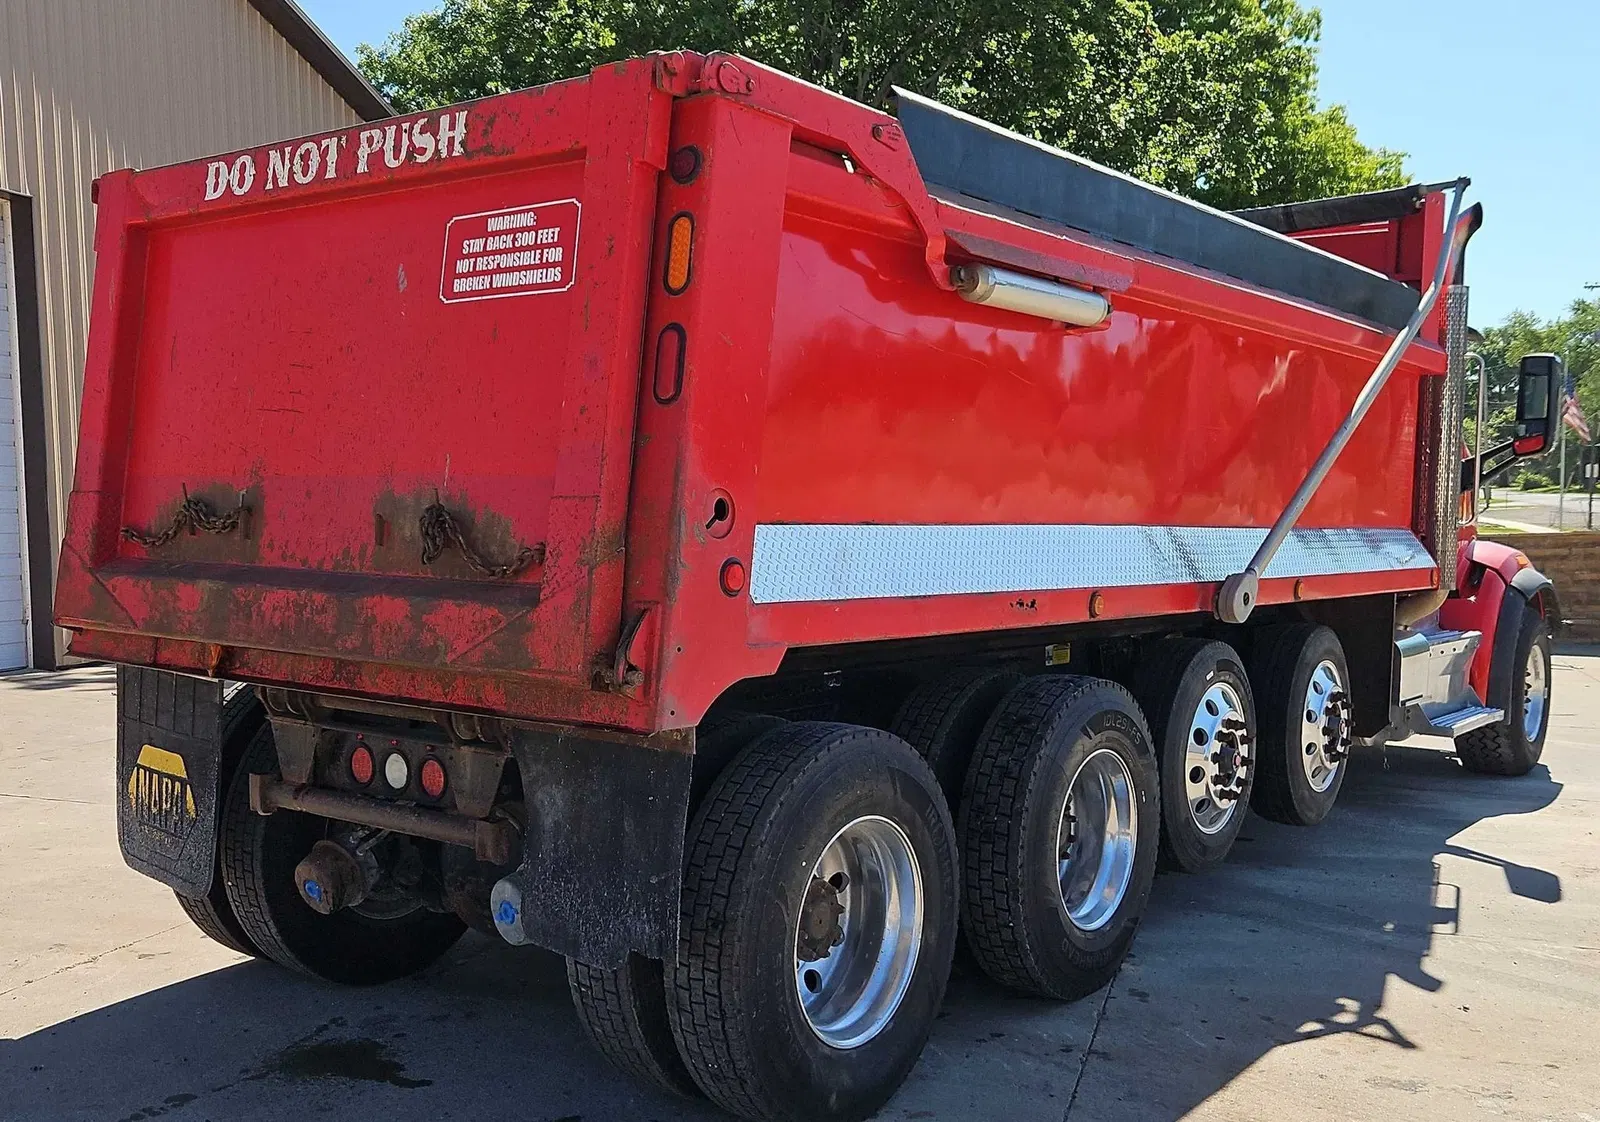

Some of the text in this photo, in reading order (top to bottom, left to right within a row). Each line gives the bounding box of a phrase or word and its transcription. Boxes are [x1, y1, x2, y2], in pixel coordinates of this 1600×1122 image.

[204, 110, 468, 201] DO NOT PUSH
[487, 211, 537, 232] WARNING:
[462, 227, 560, 254] STAY BACK 300 FEET
[455, 246, 563, 274] NOT RESPONSIBLE FOR
[492, 266, 562, 288] WINDSHIELDS
